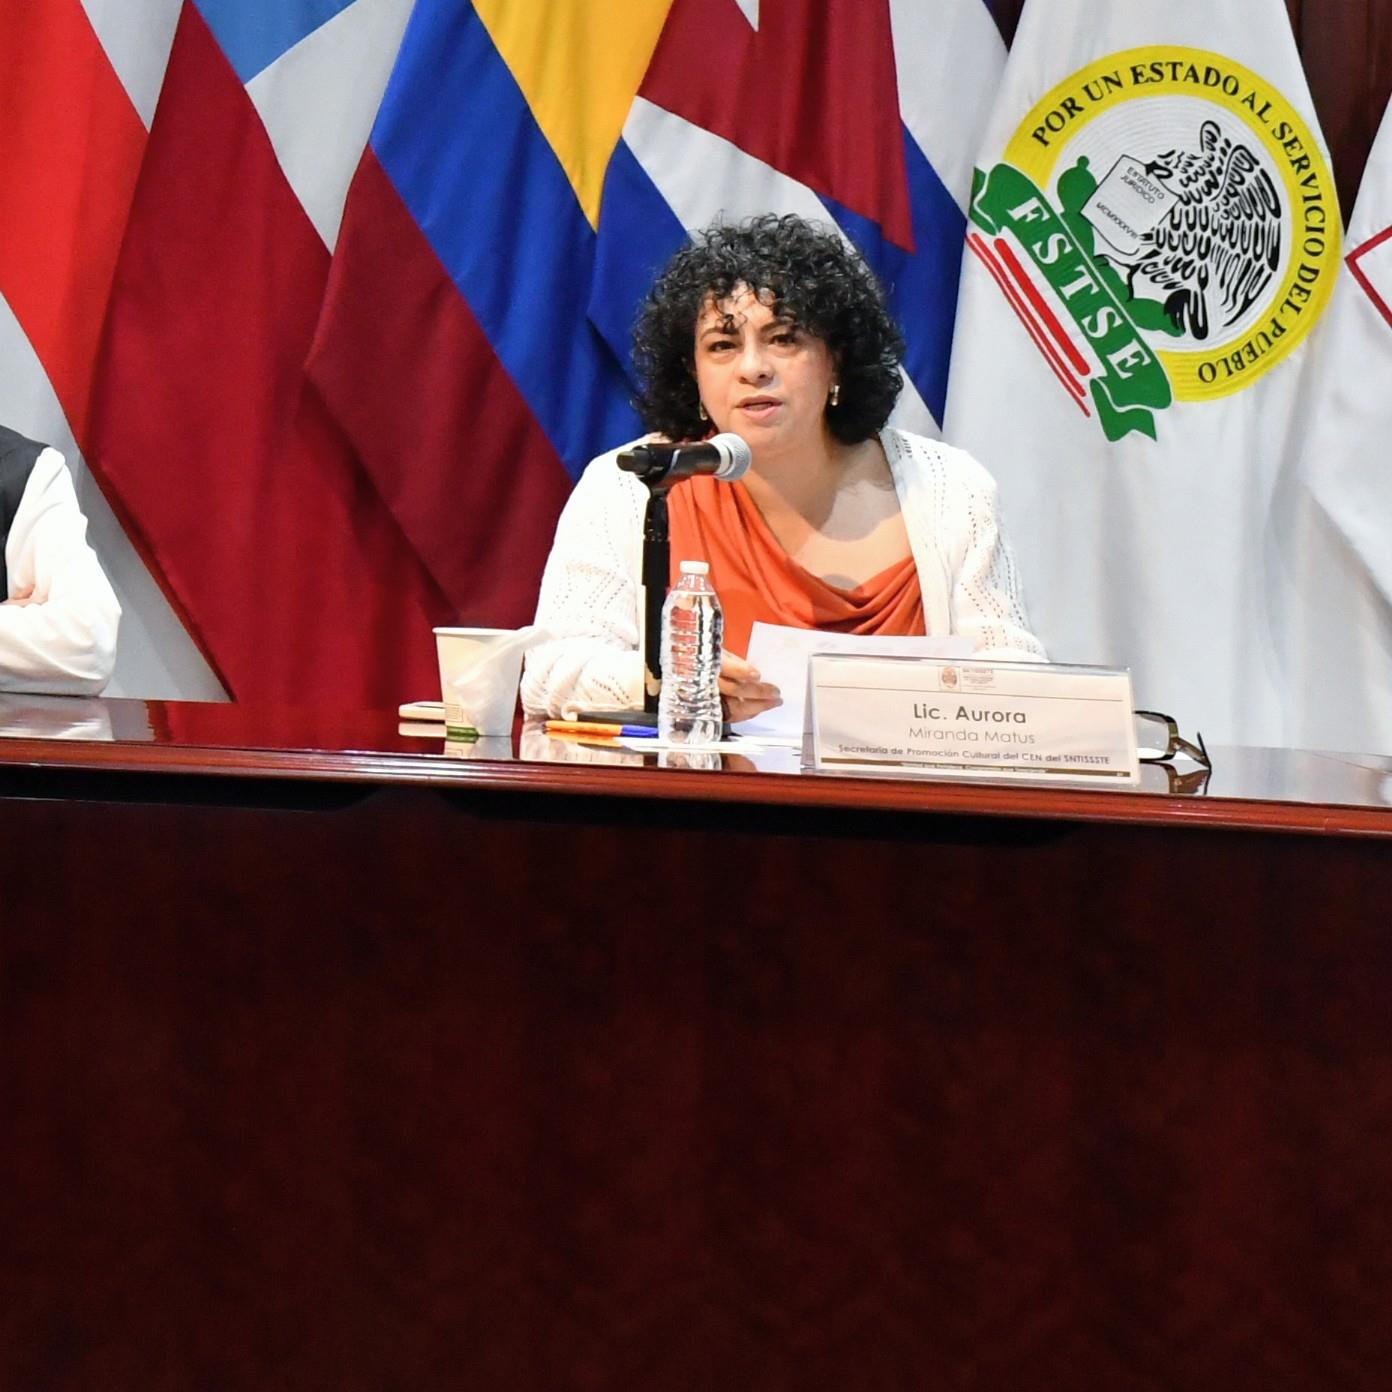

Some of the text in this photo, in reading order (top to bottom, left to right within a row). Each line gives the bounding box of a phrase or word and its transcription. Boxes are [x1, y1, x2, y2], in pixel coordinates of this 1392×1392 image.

[1031, 62, 1326, 384] POR UN ESTADO AL SERVICIO DEL PUEBLO
[1007, 196, 1151, 380] FSTSE
[913, 703, 1027, 724] Lic. Aurora
[908, 727, 1036, 744] Miranda Matus
[891, 747, 903, 755] de
[907, 748, 959, 757] Promoción
[962, 750, 1001, 759] Cultural
[1003, 752, 1019, 760] del
[1021, 753, 1042, 761] CEN
